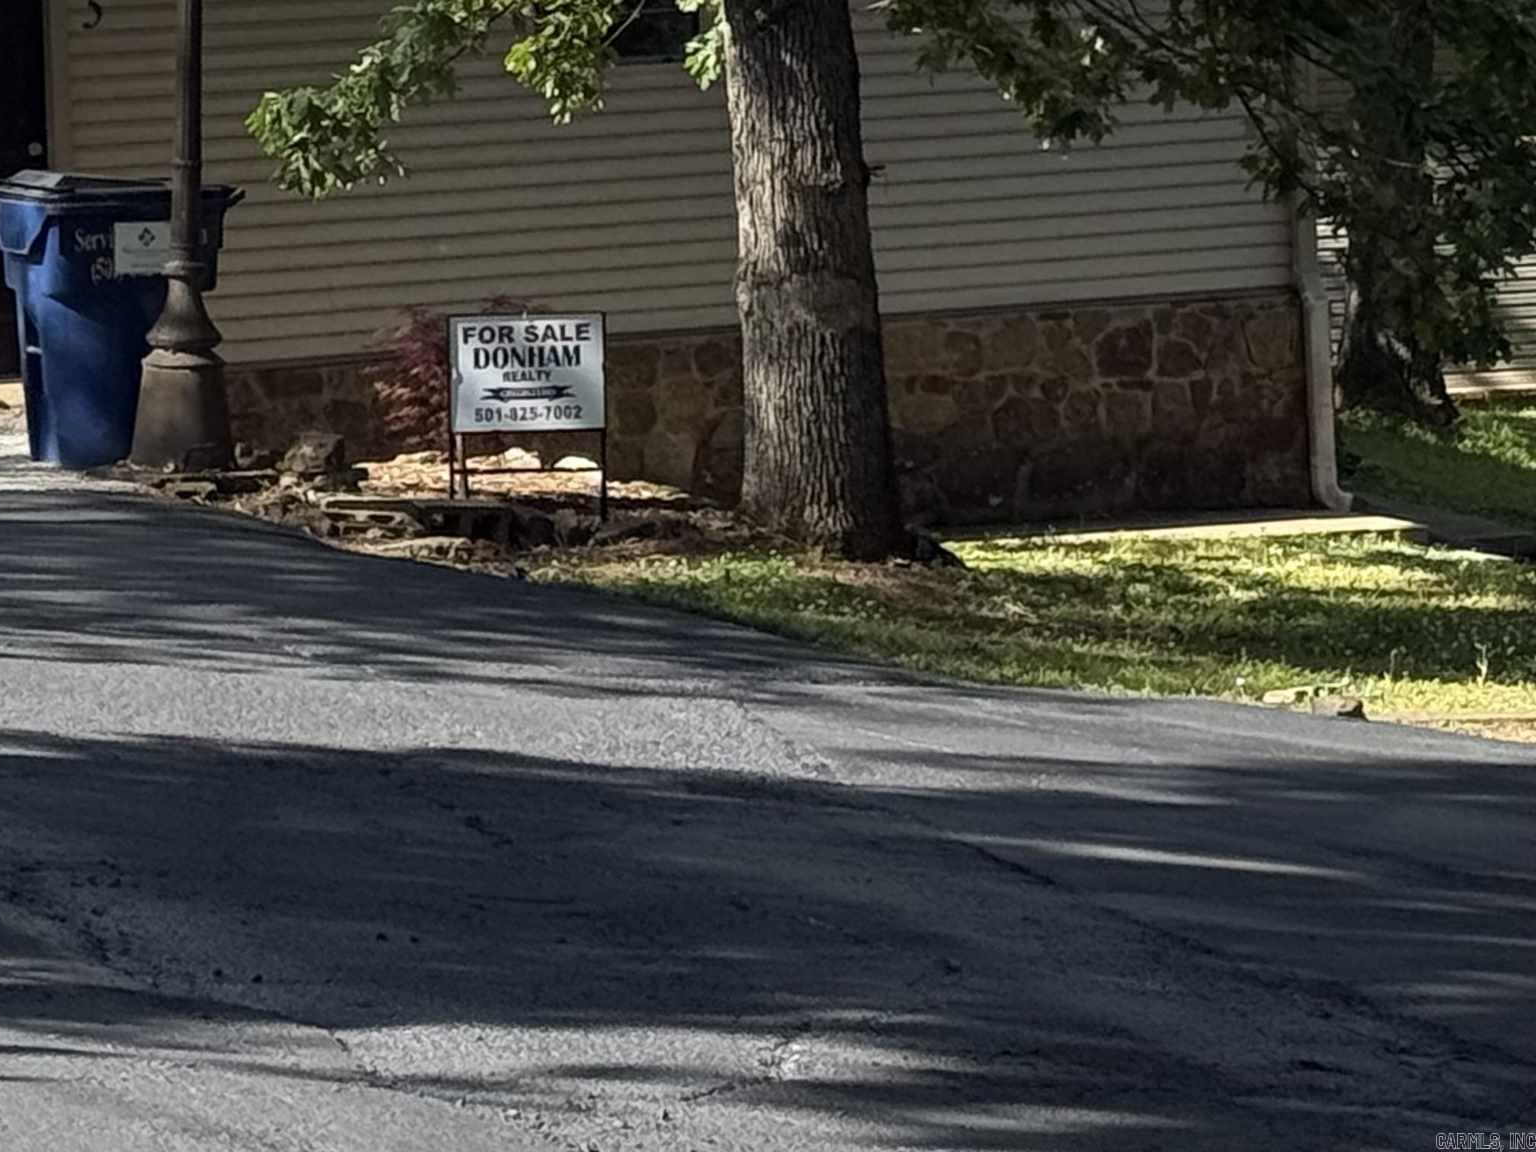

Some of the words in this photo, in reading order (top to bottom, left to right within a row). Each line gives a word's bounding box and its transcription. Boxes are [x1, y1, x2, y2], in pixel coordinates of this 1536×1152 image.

[462, 326, 515, 344] FOR
[524, 323, 591, 343] SALE
[473, 345, 582, 369] DONHAM
[503, 370, 552, 382] REALTY
